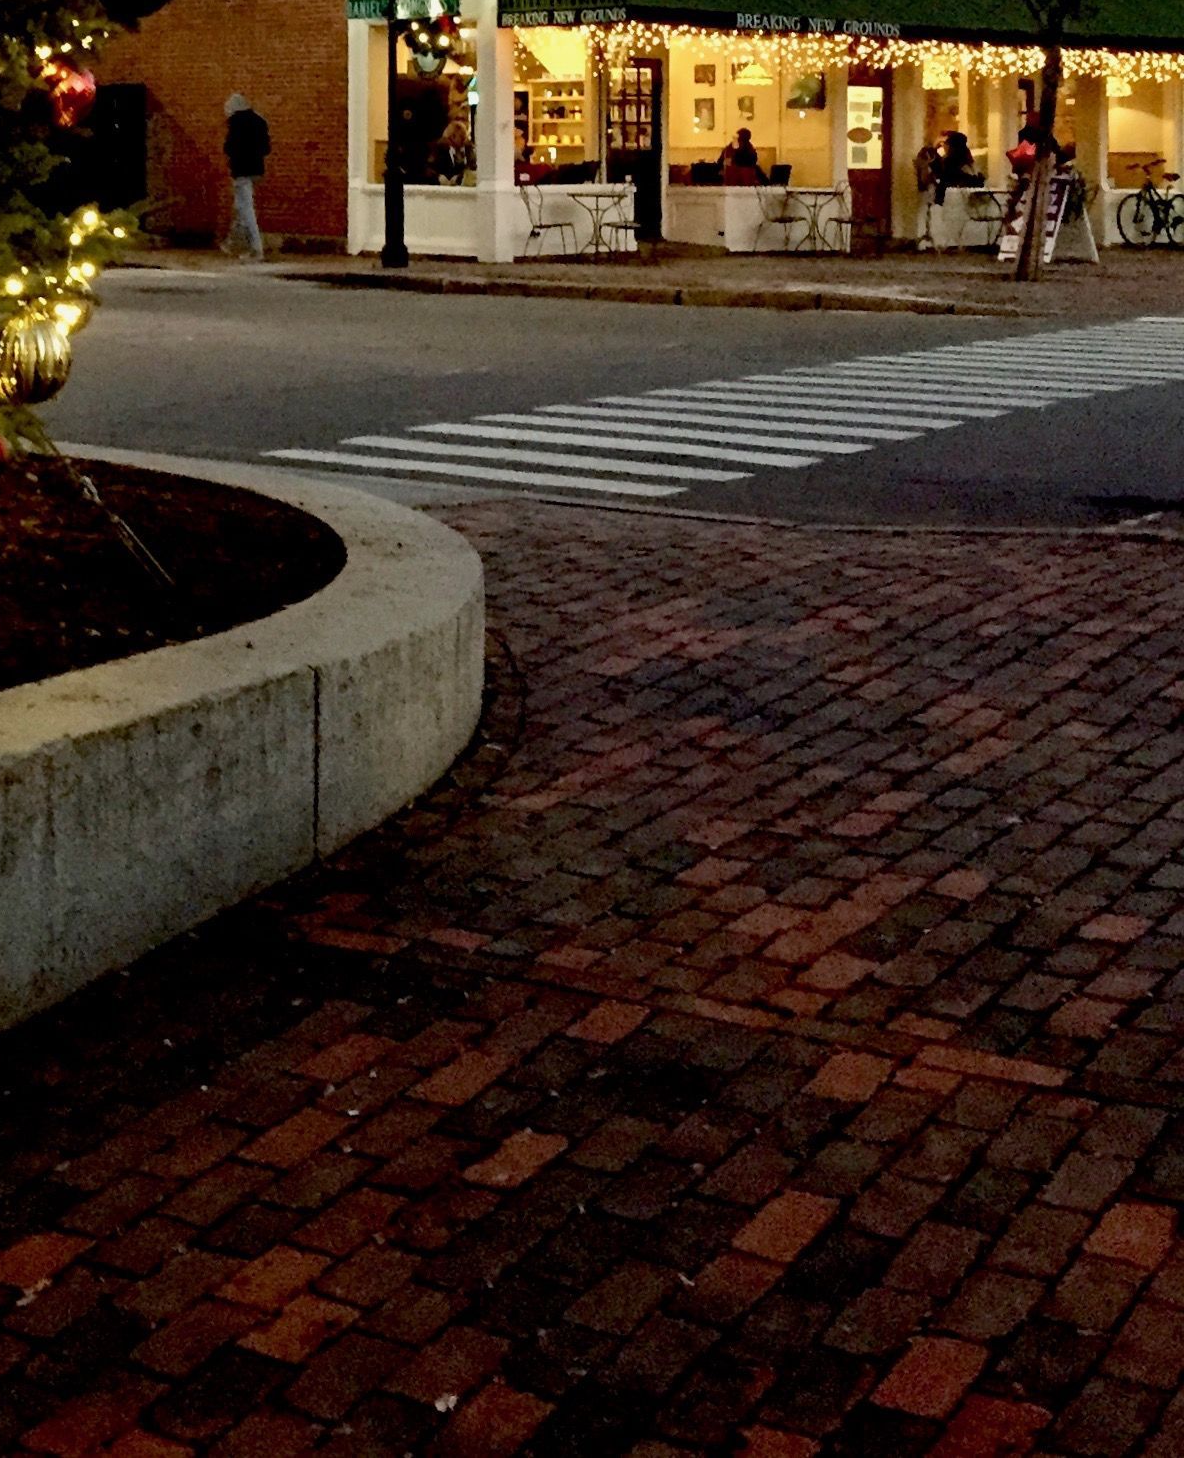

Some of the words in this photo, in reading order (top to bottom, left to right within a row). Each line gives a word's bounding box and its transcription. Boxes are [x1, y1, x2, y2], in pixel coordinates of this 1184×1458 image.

[347, 0, 381, 17] DANIEL
[502, 12, 548, 27] BREAKING
[553, 10, 576, 25] NEW
[580, 7, 627, 23] GROUNDS
[736, 12, 801, 31] BREAKING
[808, 17, 837, 32] NEW
[843, 20, 901, 37] GROUNDS
